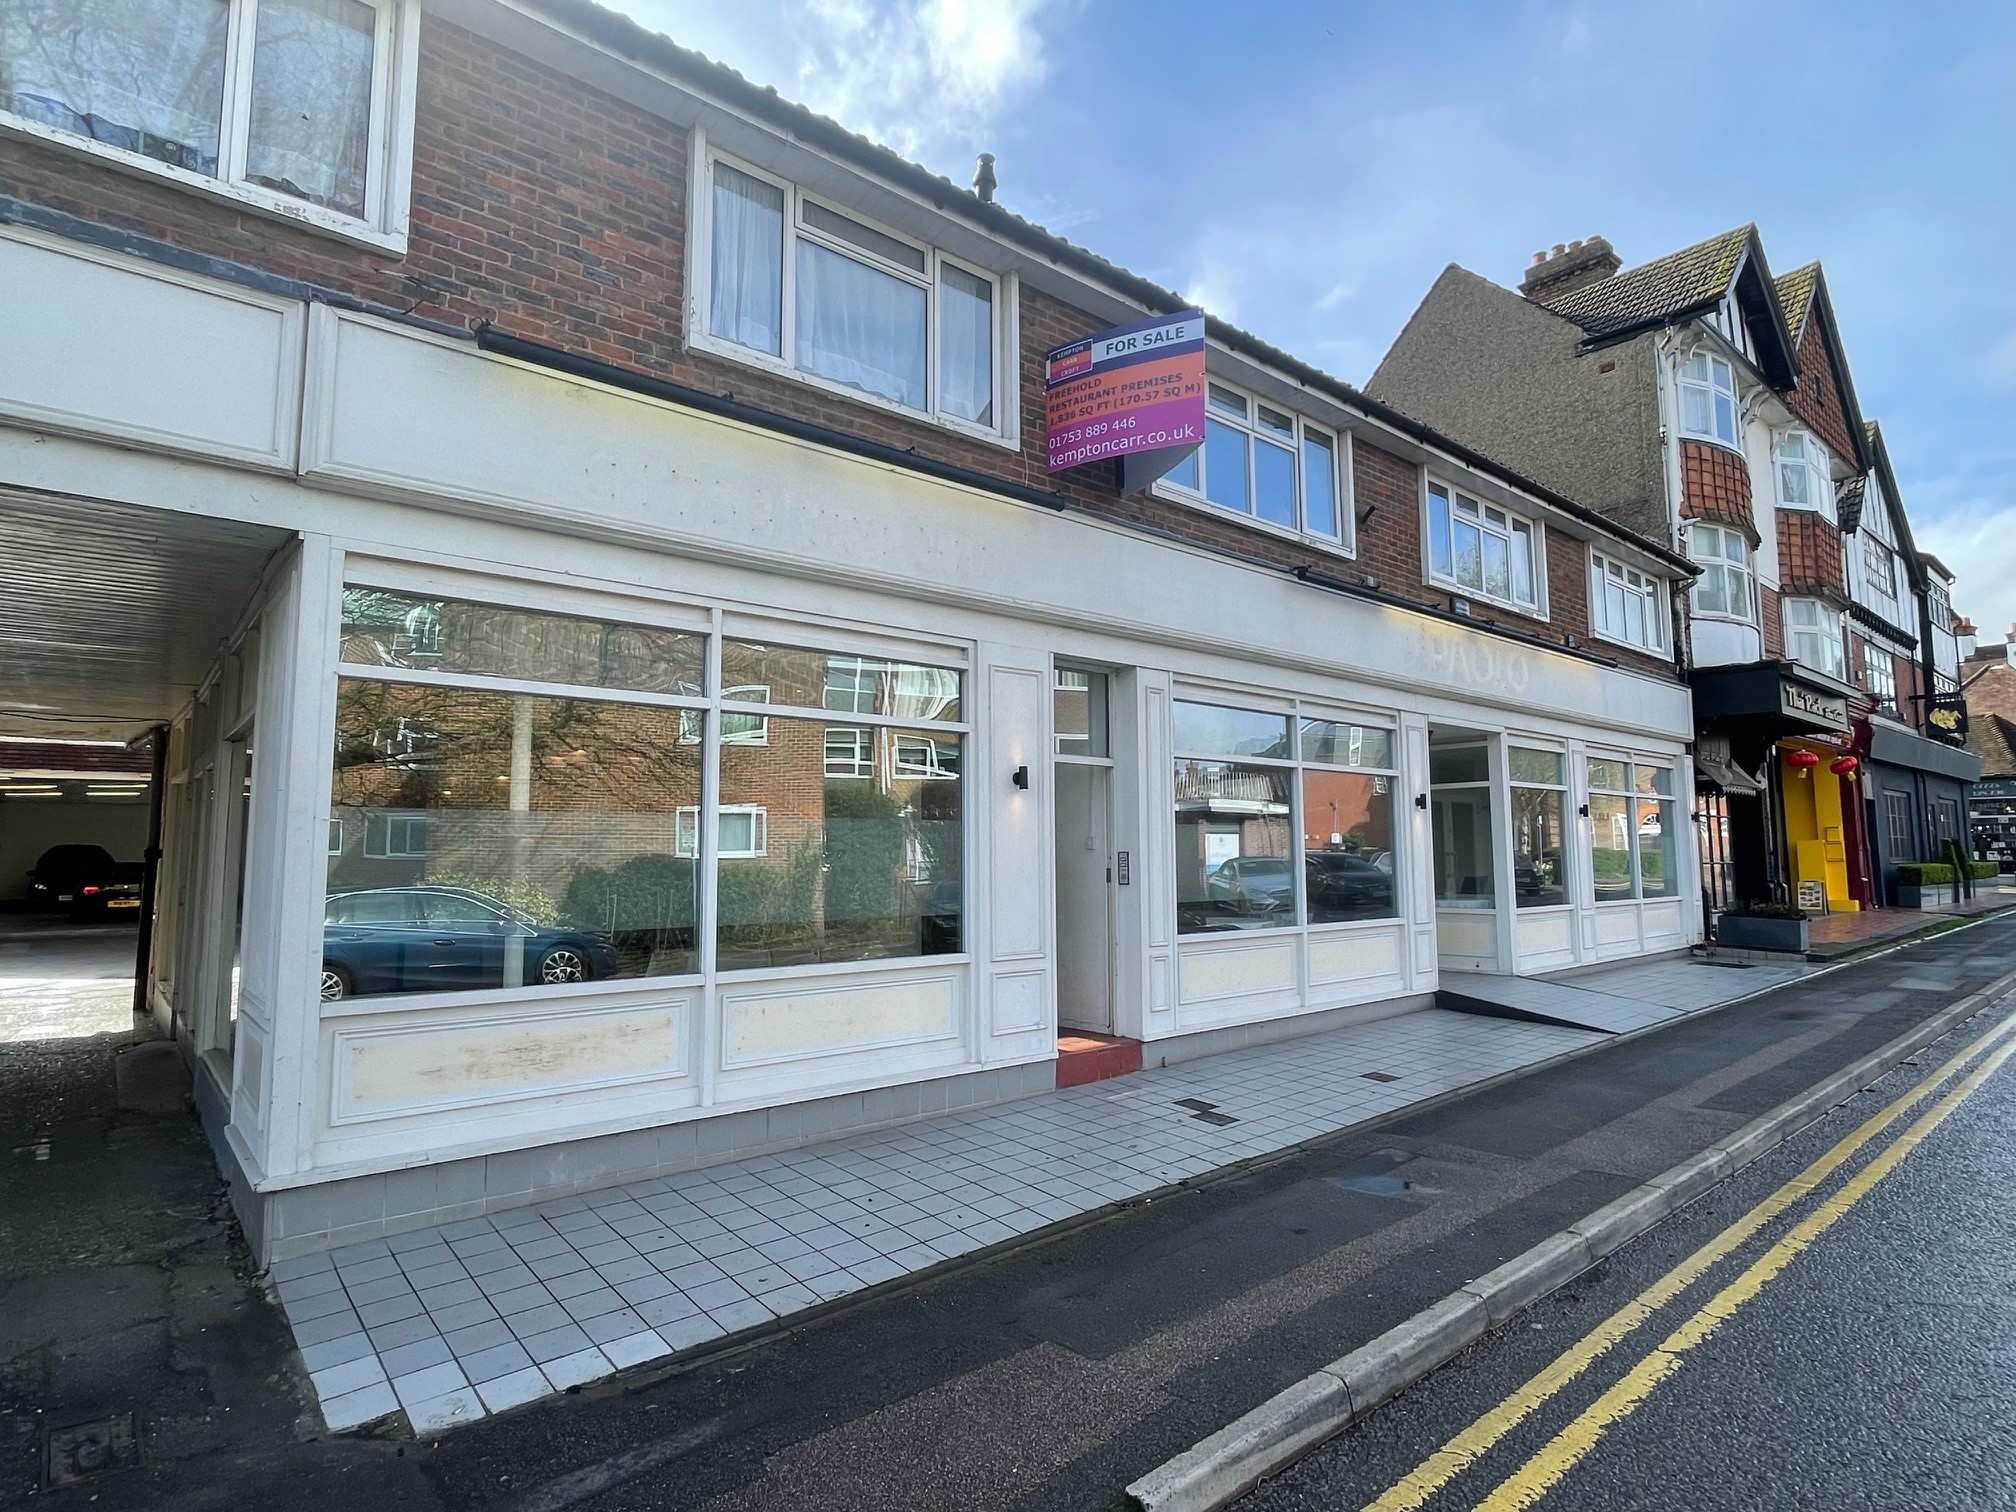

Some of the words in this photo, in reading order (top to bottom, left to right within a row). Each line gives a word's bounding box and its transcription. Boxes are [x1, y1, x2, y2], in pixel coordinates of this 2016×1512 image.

[1057, 344, 1084, 359] KEMPTON
[1106, 338, 1137, 356] FOR
[1143, 326, 1185, 346] SALE
[1060, 366, 1080, 377] CROFT
[1049, 378, 1102, 402] FREEHOLD
[1049, 386, 1117, 414] RESTAURANT
[1121, 372, 1184, 392] PREMISES
[1078, 405, 1094, 417] SQ
[1097, 401, 1110, 411] FT
[1113, 390, 1160, 410] (170.57
[1164, 387, 1181, 397] SQ
[1184, 382, 1201, 394] M)
[1049, 429, 1083, 450] 01753
[1085, 422, 1108, 439] 889
[1112, 416, 1136, 431] 446
[1049, 423, 1195, 468] kemptoncarr.co.uk
